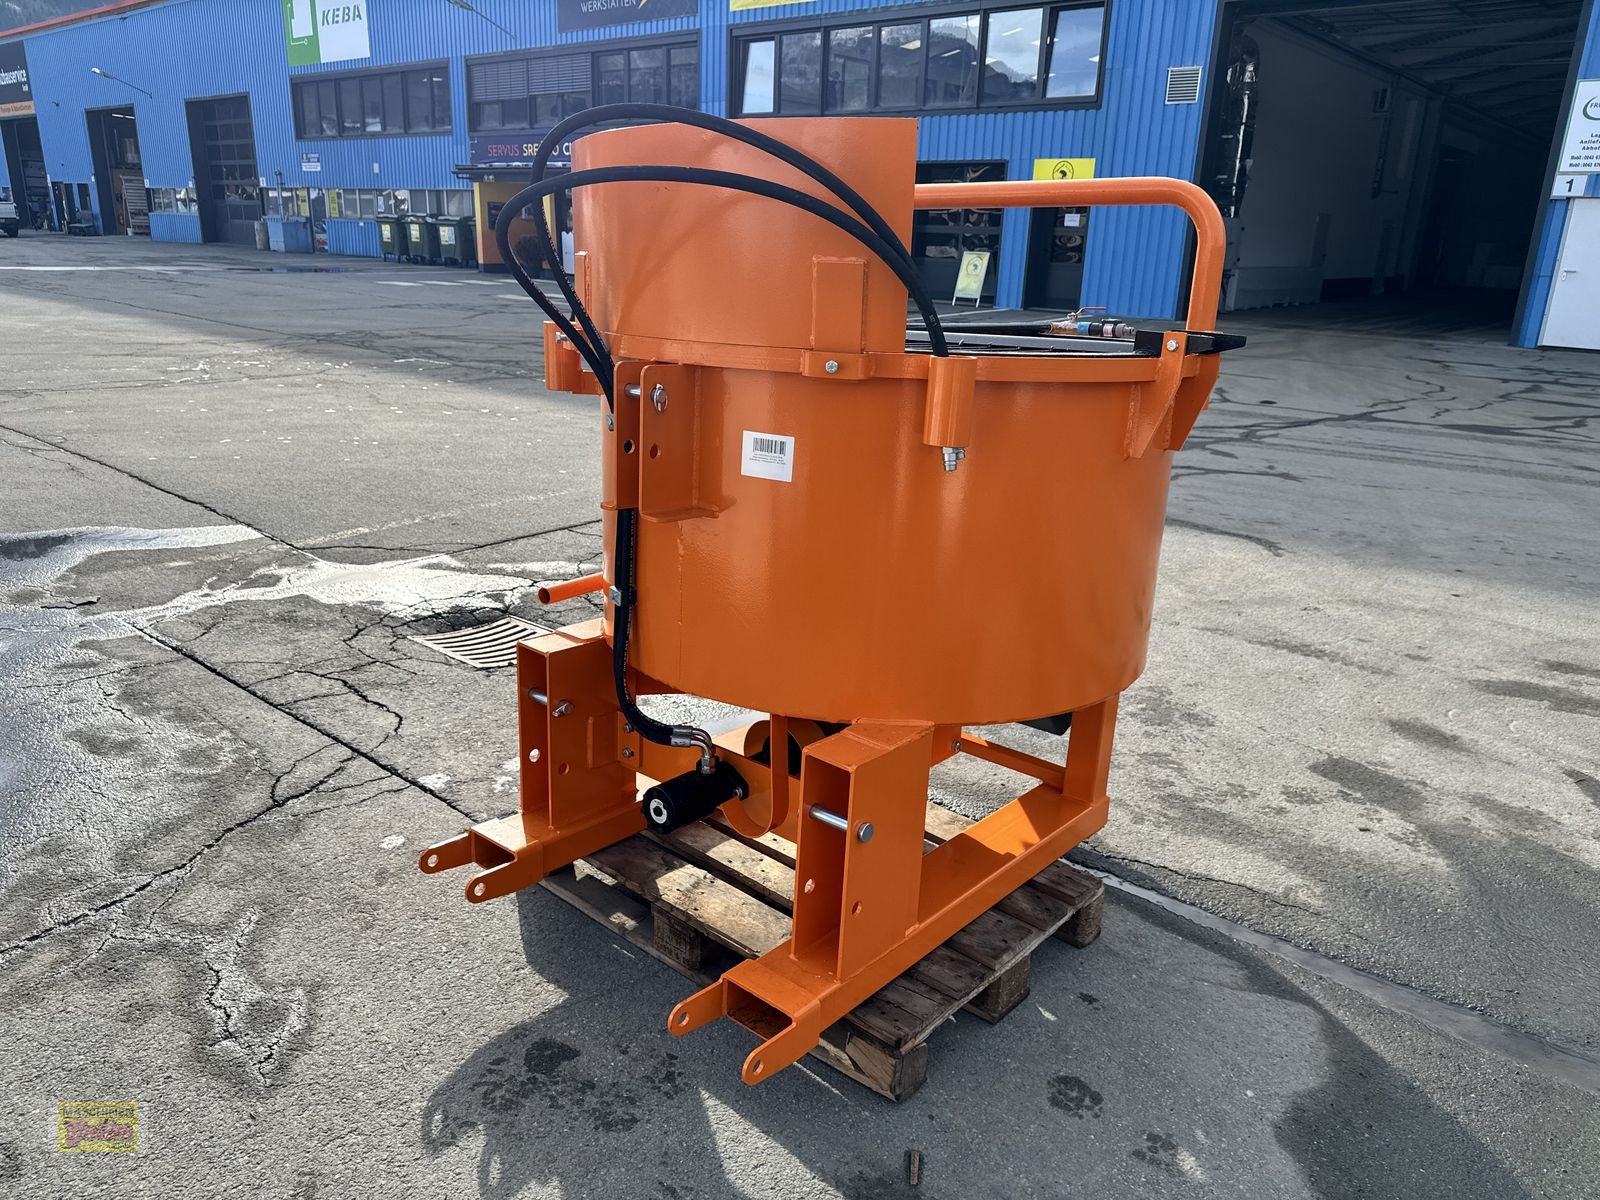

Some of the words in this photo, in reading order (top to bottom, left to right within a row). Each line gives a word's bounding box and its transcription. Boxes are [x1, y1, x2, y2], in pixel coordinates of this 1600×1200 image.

[321, 4, 362, 26] KEBA
[487, 144, 520, 157] SERVUS
[1566, 178, 1574, 193] 1
